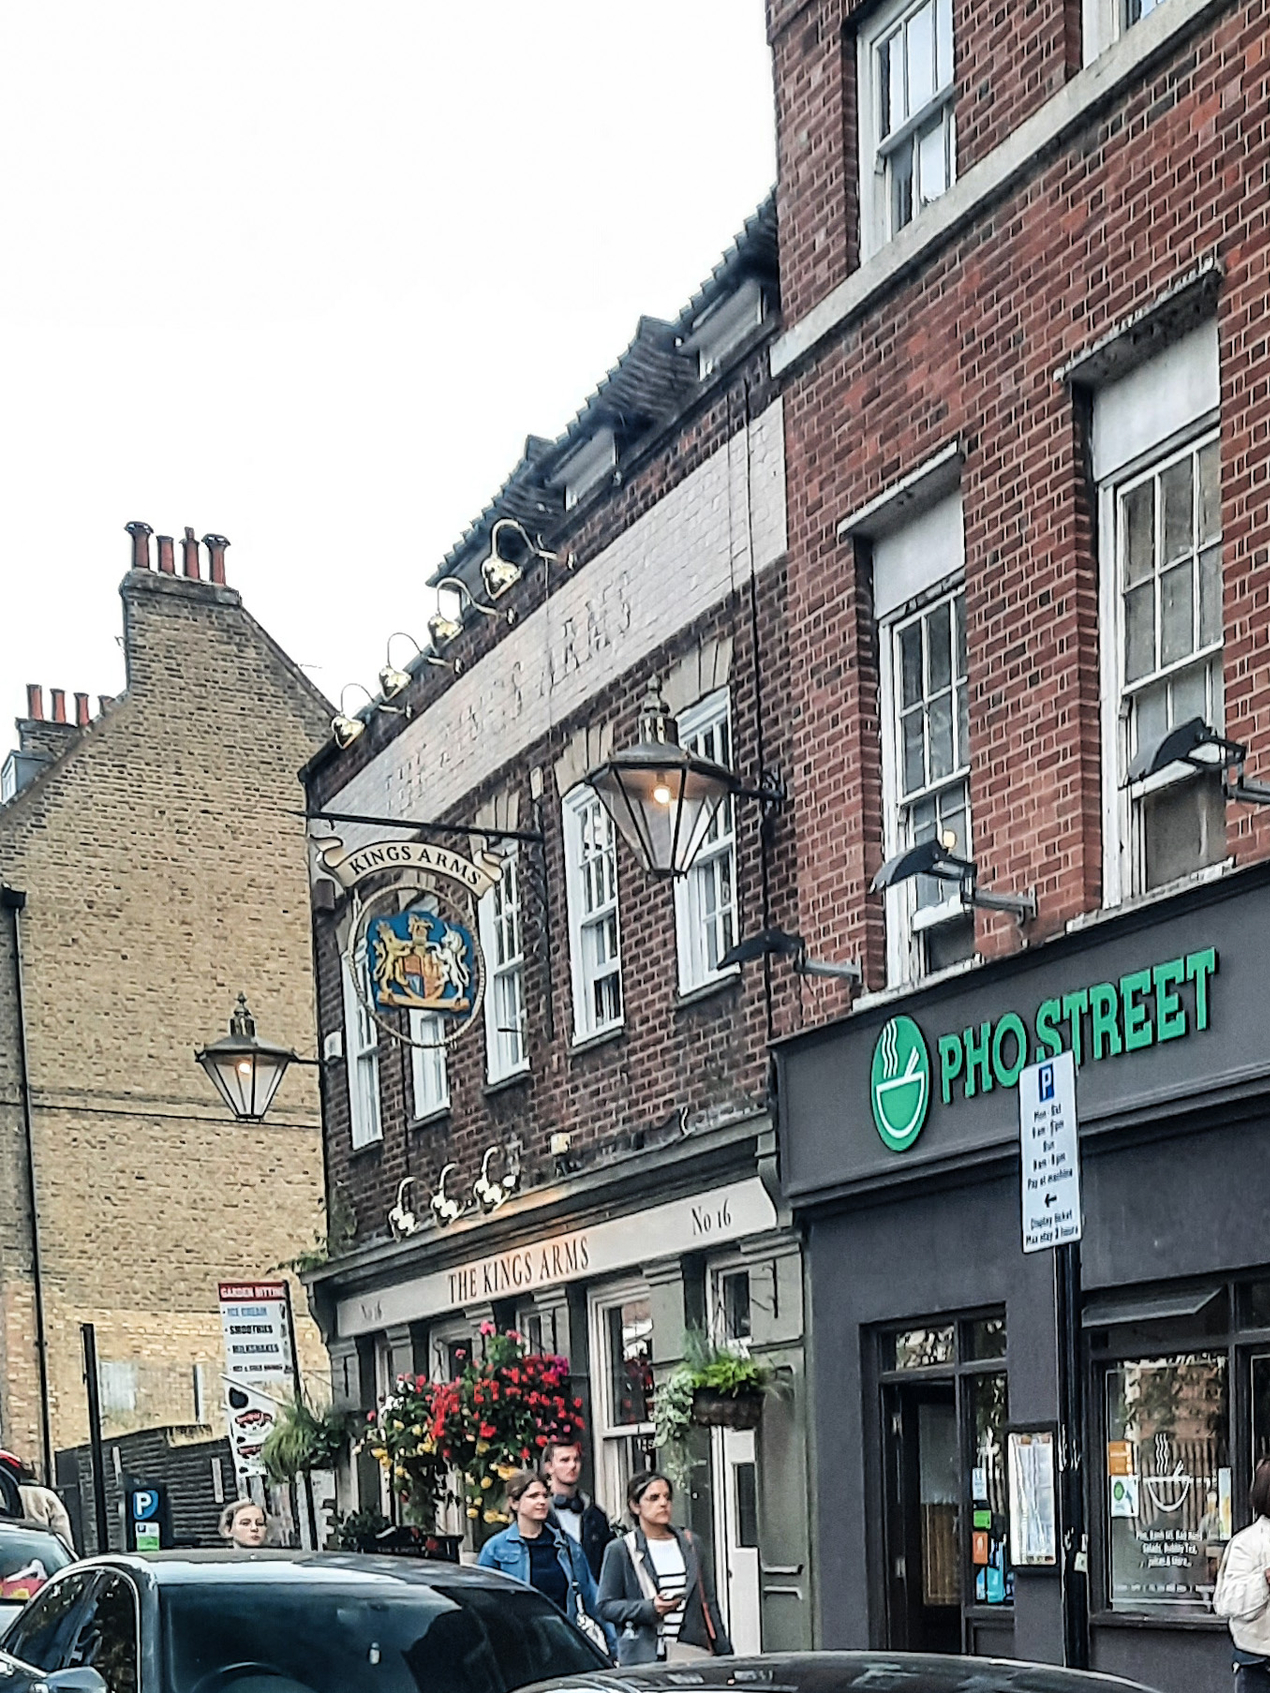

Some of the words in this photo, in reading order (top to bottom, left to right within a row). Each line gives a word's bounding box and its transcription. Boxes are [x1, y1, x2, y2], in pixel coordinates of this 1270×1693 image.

[349, 846, 412, 876] KINGS
[417, 851, 482, 886] ARMS
[938, 1012, 1027, 1105] PHO
[1035, 946, 1217, 1068] STREET
[1041, 1067, 1052, 1099] P
[691, 1205, 711, 1236] No
[717, 1197, 731, 1229] 16
[449, 1268, 477, 1304] THE
[483, 1252, 533, 1294] KINGS
[540, 1236, 589, 1281] ARMS
[230, 1325, 273, 1334] SMOOTHIES
[136, 1491, 152, 1516] P
